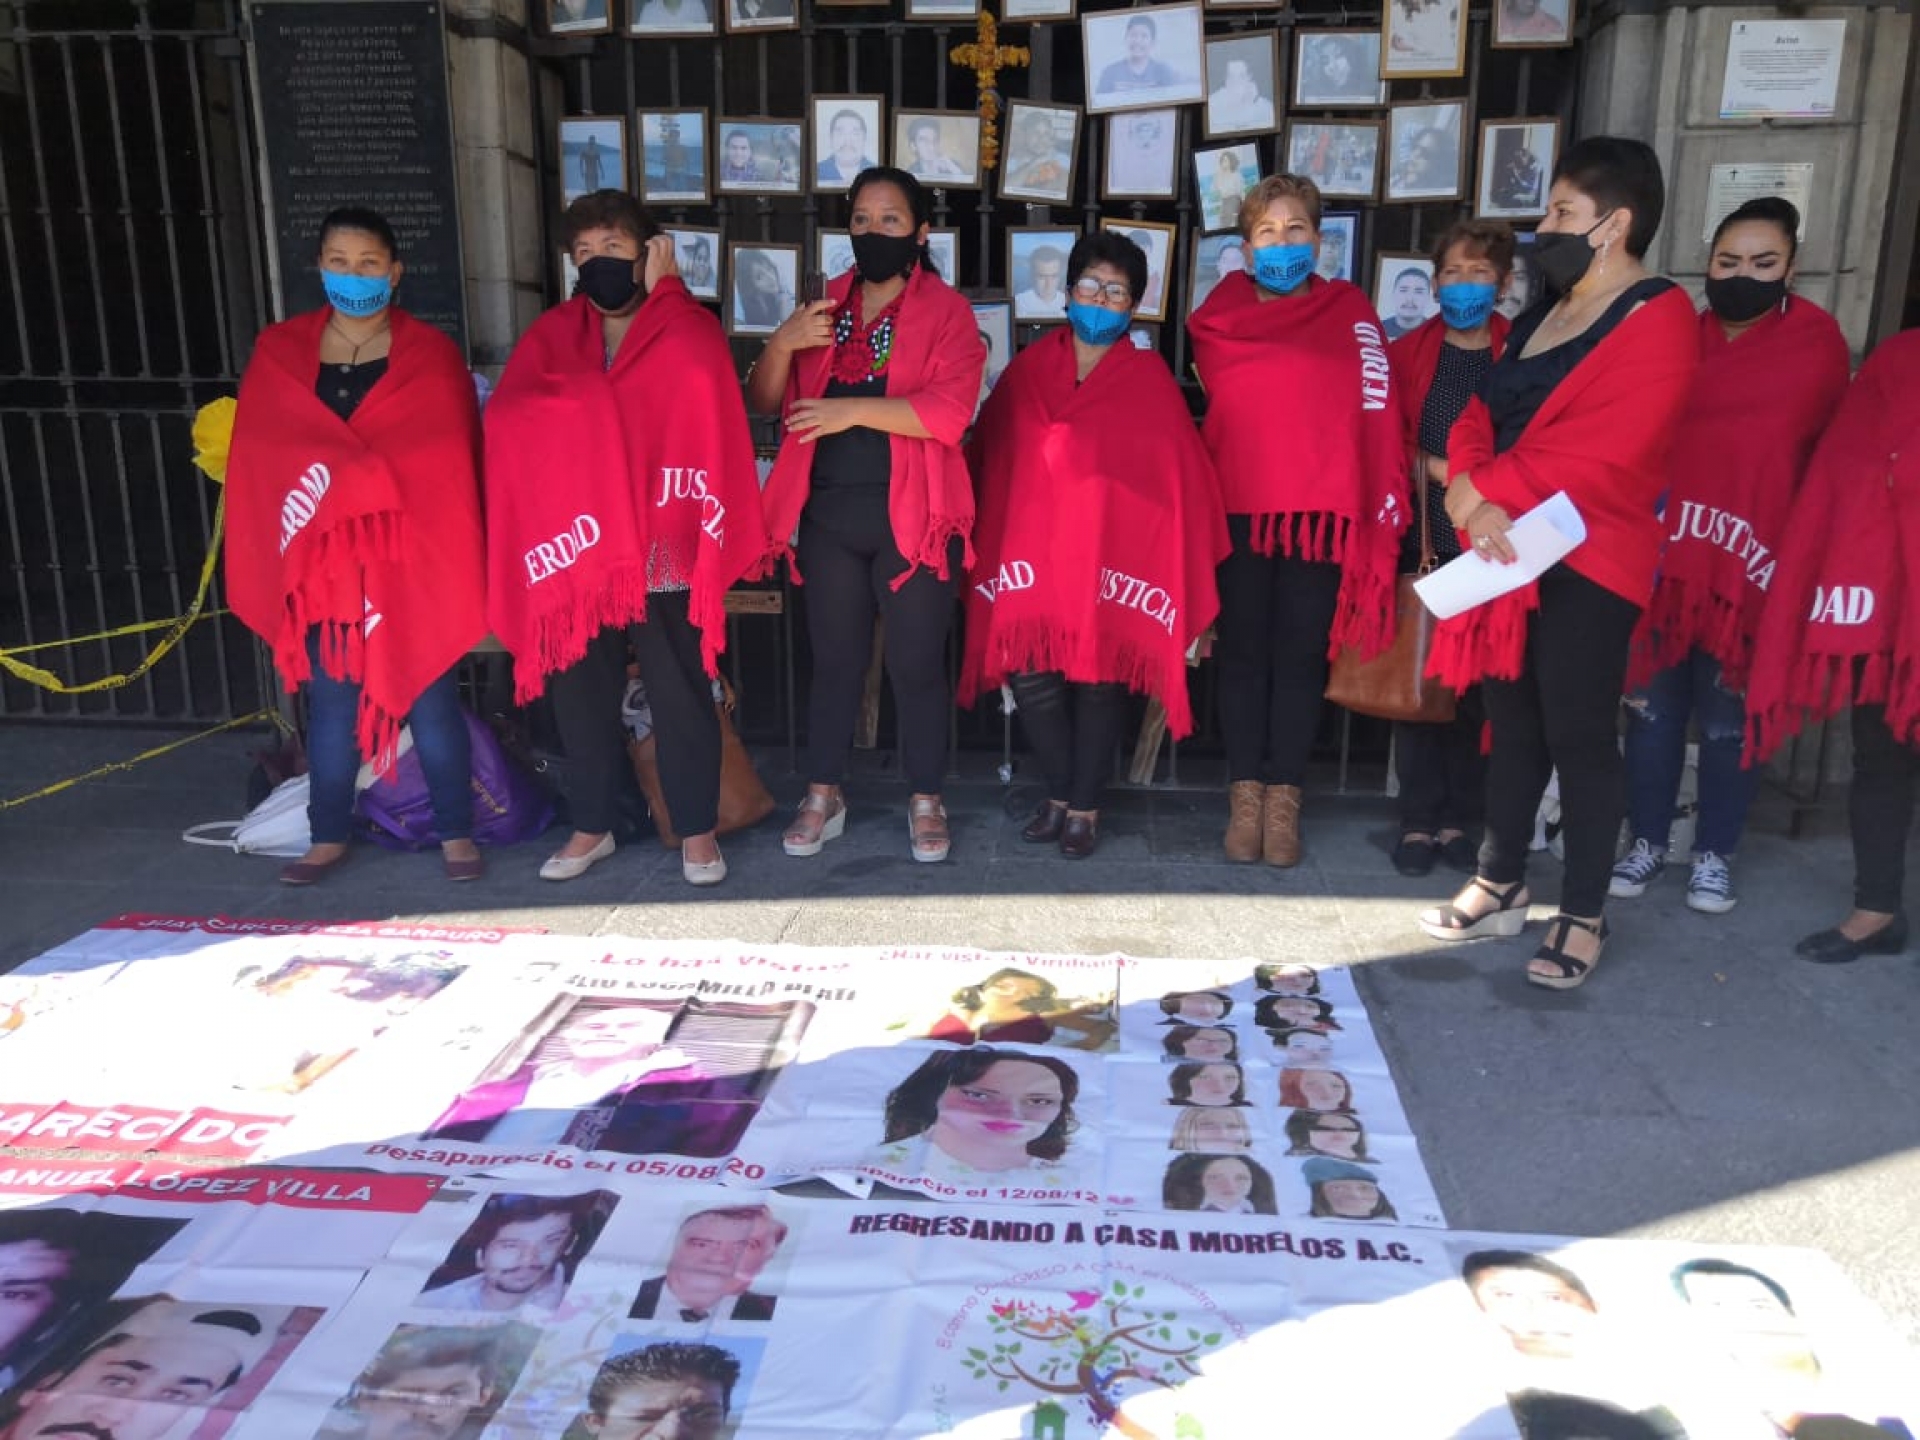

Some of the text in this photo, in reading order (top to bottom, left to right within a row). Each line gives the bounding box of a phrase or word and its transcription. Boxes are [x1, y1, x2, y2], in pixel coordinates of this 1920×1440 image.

[123, 1169, 260, 1195] LÓPEZ
[266, 1177, 372, 1201] VILLA
[849, 1212, 1425, 1264] REGRESANDO A CASA MORELOS A.C.
